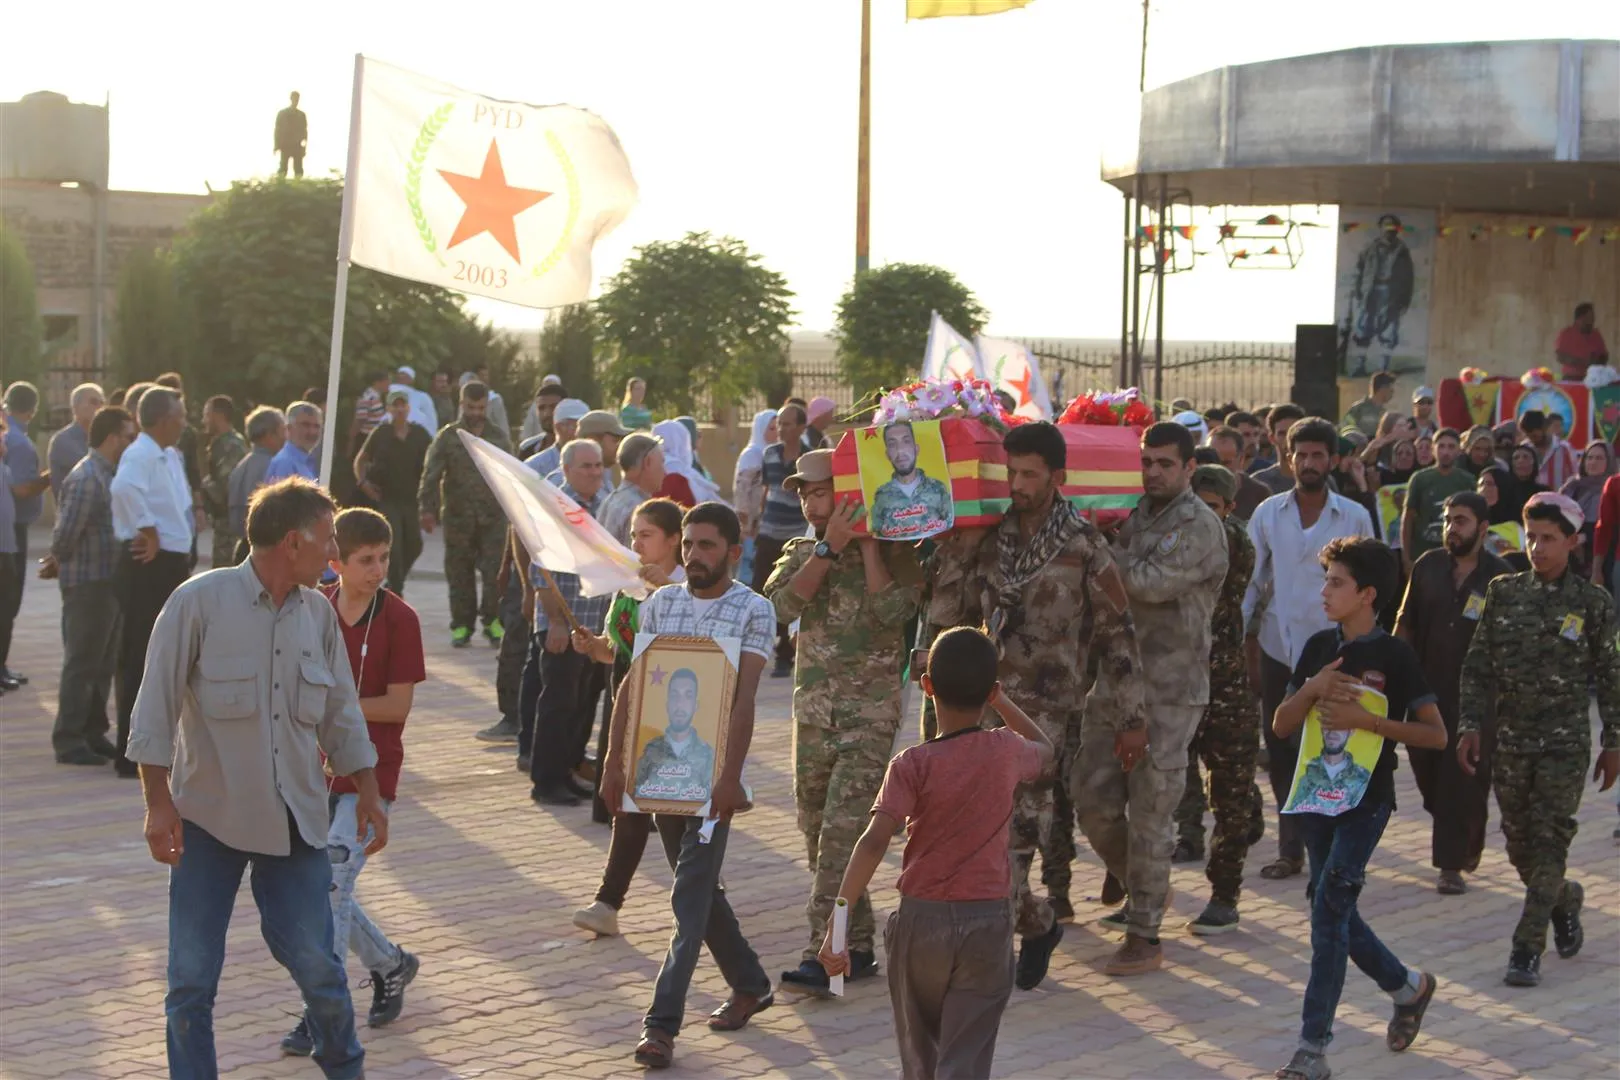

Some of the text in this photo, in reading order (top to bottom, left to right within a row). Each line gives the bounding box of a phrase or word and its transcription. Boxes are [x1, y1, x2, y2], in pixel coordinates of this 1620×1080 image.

[474, 102, 523, 129] PYD
[453, 259, 507, 289] 2003
[892, 504, 927, 520] الشهيد
[657, 764, 691, 779] الشهيد
